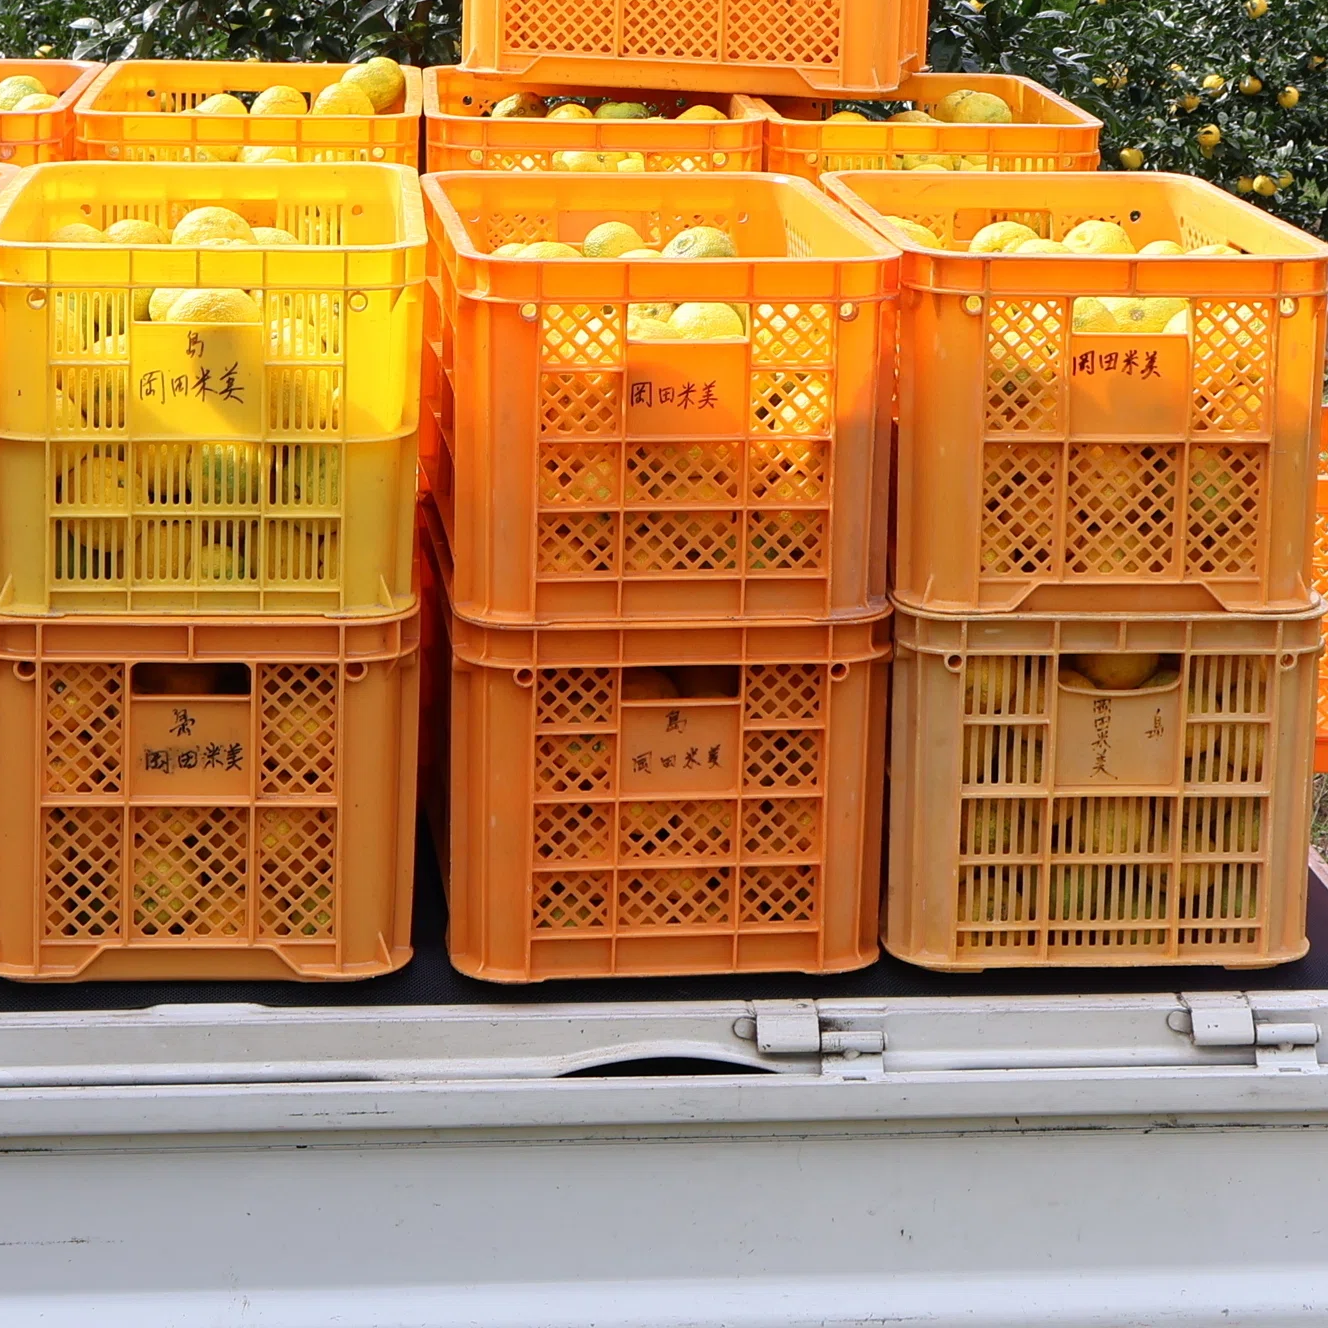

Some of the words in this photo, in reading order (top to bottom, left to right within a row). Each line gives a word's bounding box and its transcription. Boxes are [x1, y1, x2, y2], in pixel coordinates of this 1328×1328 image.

[1072, 349, 1161, 380] 岡田米美
[139, 361, 245, 405] 岡田米美
[630, 380, 719, 410] 岡田米美
[144, 742, 244, 774] 岡田米美
